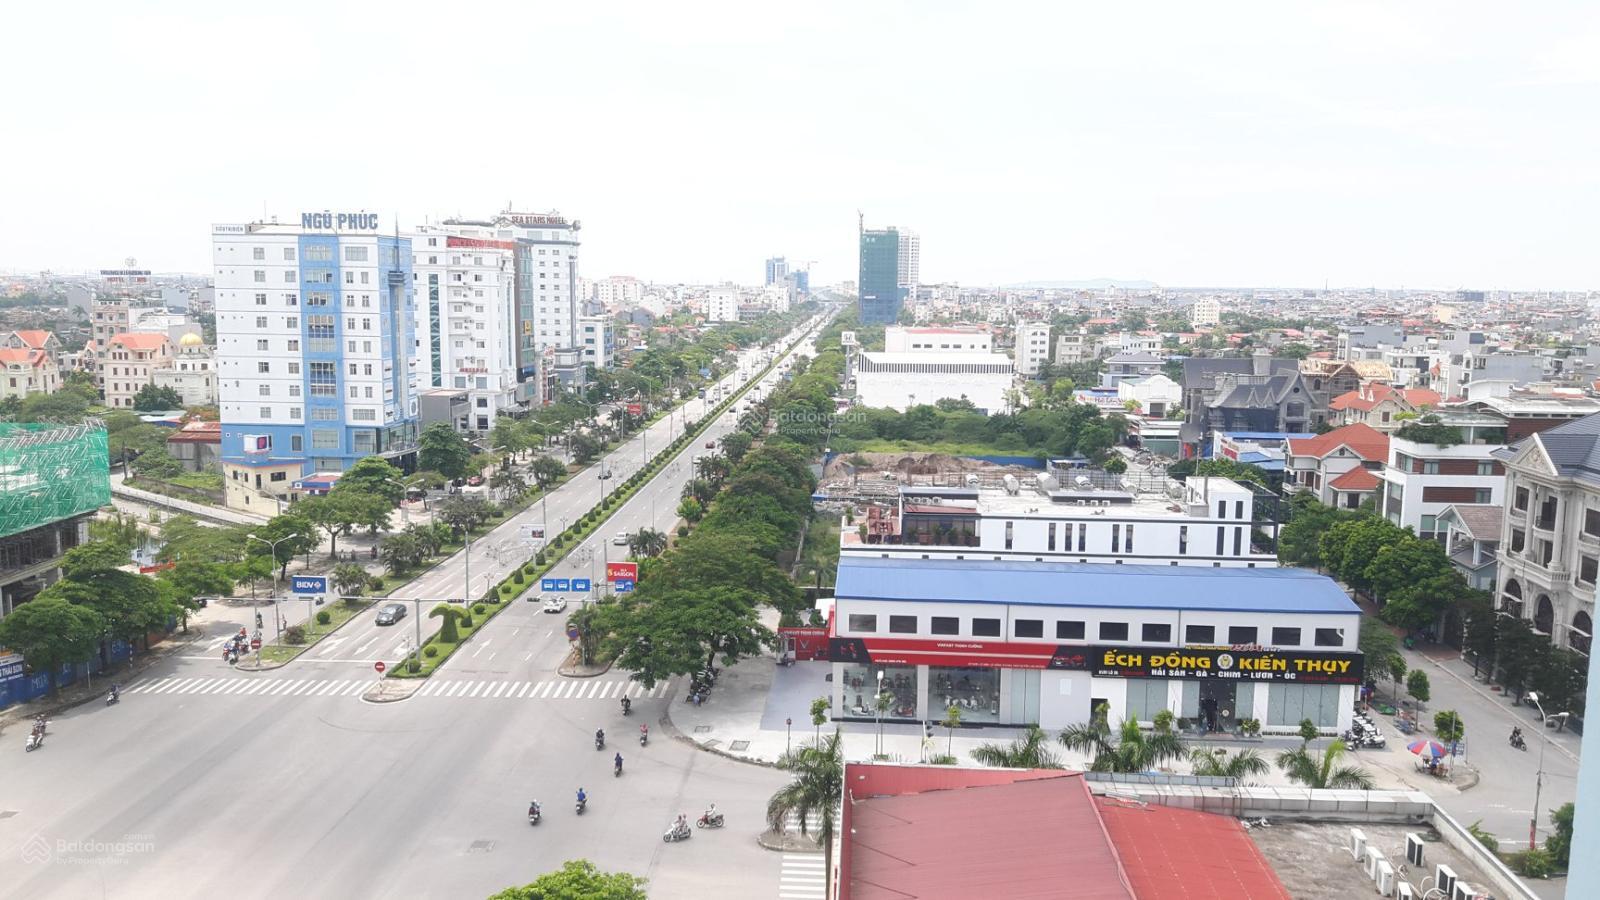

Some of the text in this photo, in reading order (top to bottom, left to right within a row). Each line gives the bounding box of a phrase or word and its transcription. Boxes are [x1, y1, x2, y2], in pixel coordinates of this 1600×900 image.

[302, 209, 378, 230] NGŨ PHÚC
[511, 216, 523, 224] SEA
[525, 216, 545, 224] STARS
[296, 581, 314, 589] BIDV
[1103, 649, 1351, 675] ẾCH ĐỒNG KIẾN THỤY
[1152, 667, 1166, 676] HẢI
[1168, 667, 1186, 677] SẢN
[1196, 668, 1207, 677] GÀ
[1284, 669, 1296, 680] ỐC
